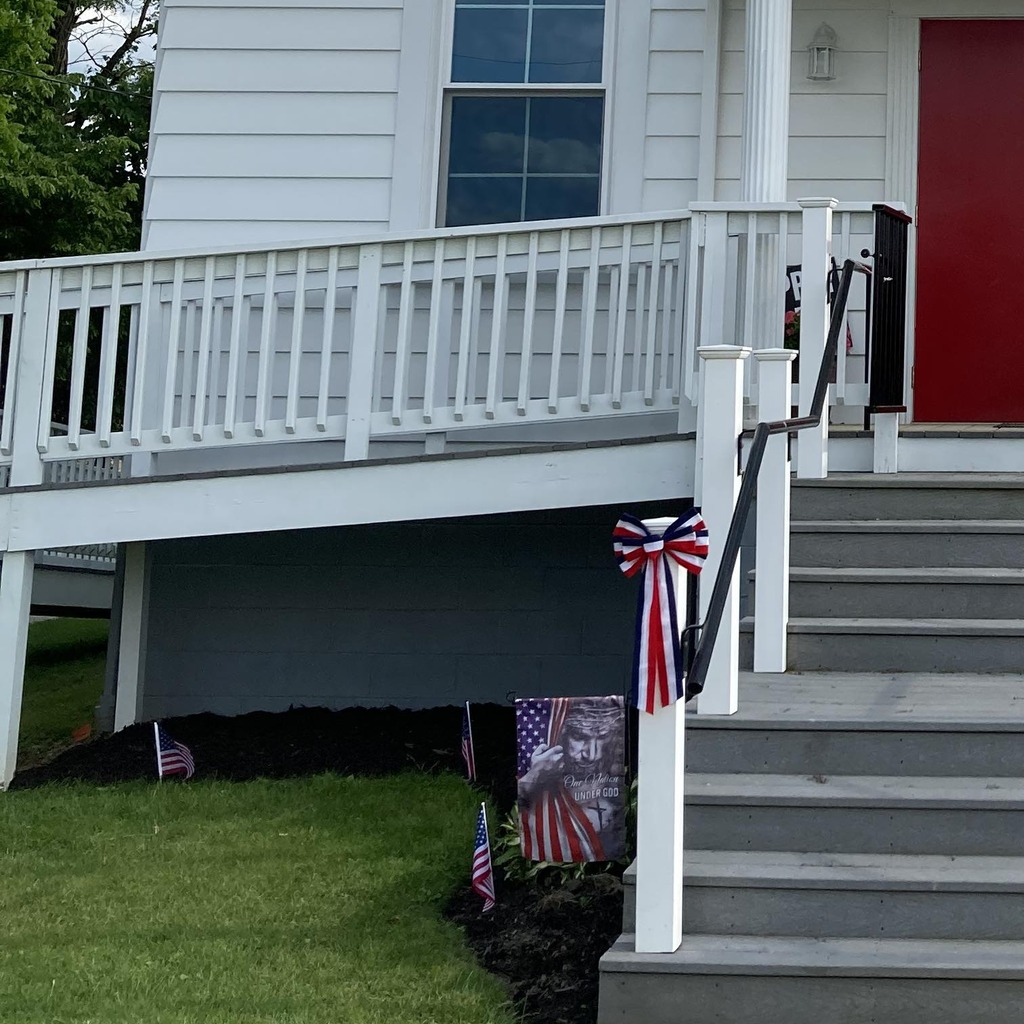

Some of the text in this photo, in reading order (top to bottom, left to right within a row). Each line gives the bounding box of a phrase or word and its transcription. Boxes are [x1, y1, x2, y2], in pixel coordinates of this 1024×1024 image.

[564, 774, 583, 788] One
[575, 787, 619, 801] UNDER GOD
